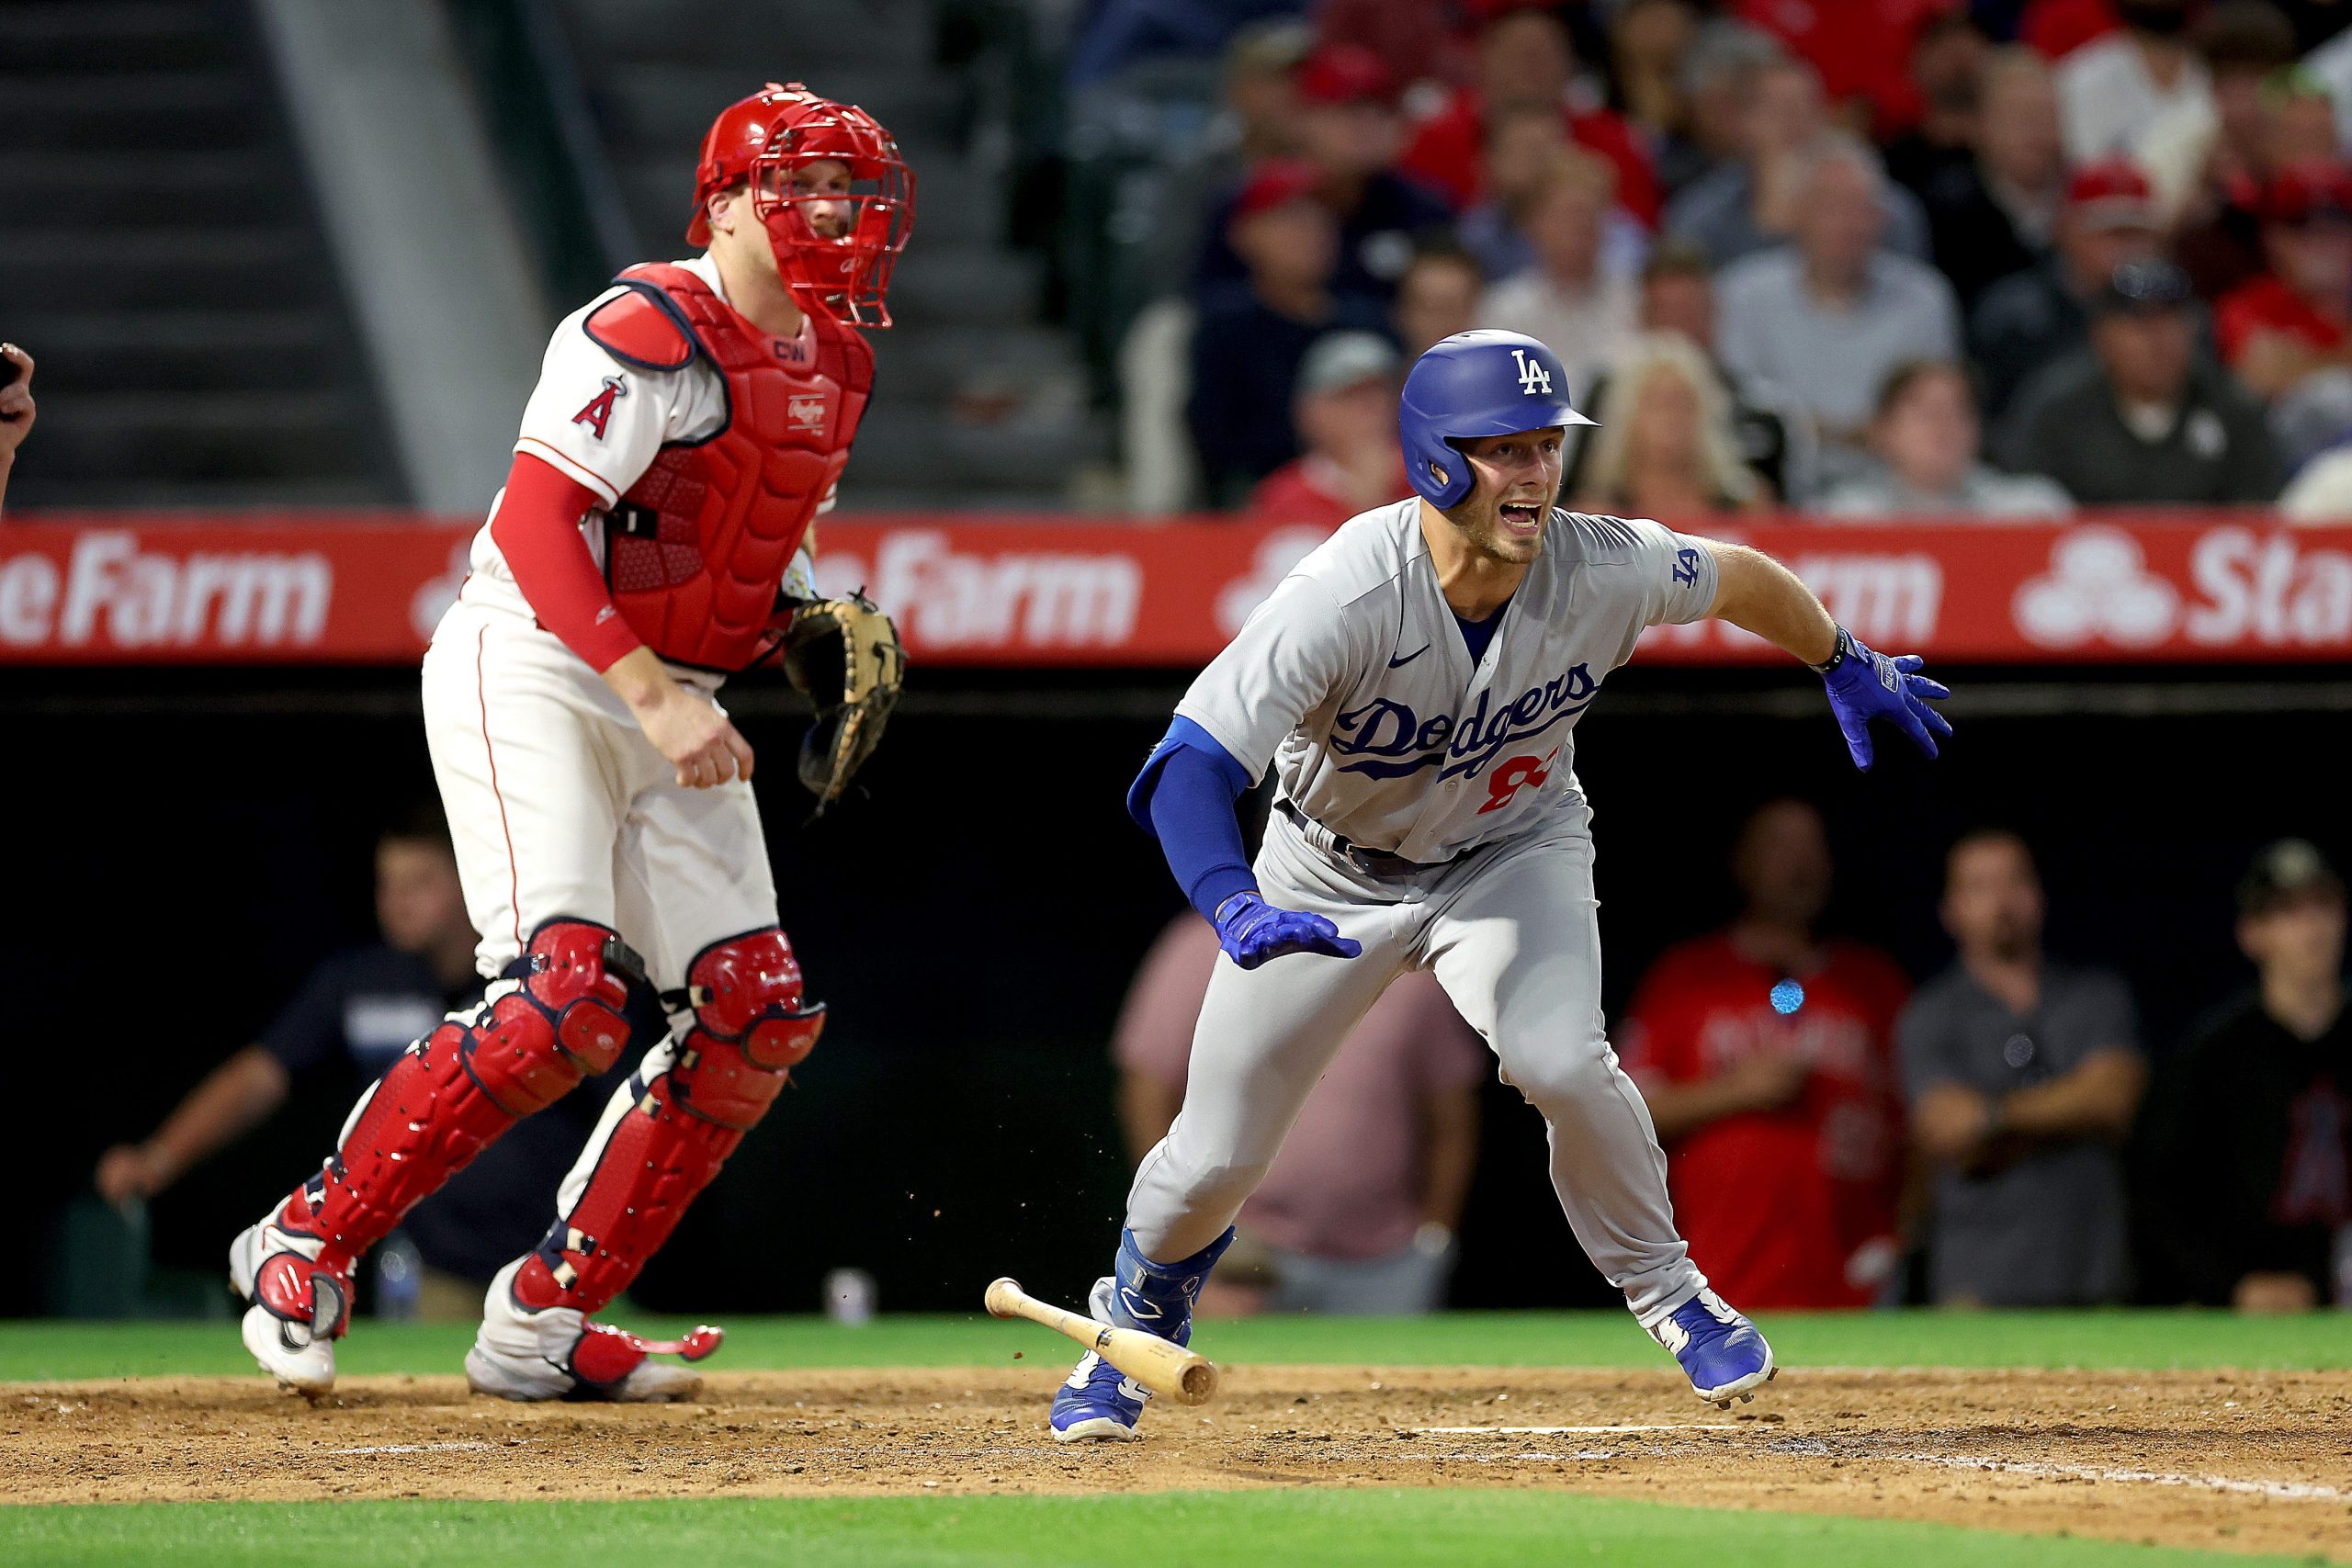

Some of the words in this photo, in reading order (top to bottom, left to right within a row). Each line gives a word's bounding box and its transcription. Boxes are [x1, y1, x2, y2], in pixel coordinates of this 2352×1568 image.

[1510, 349, 1553, 395] LA
[1672, 548, 1700, 590] LA
[1329, 661, 1601, 781] Dodgers
